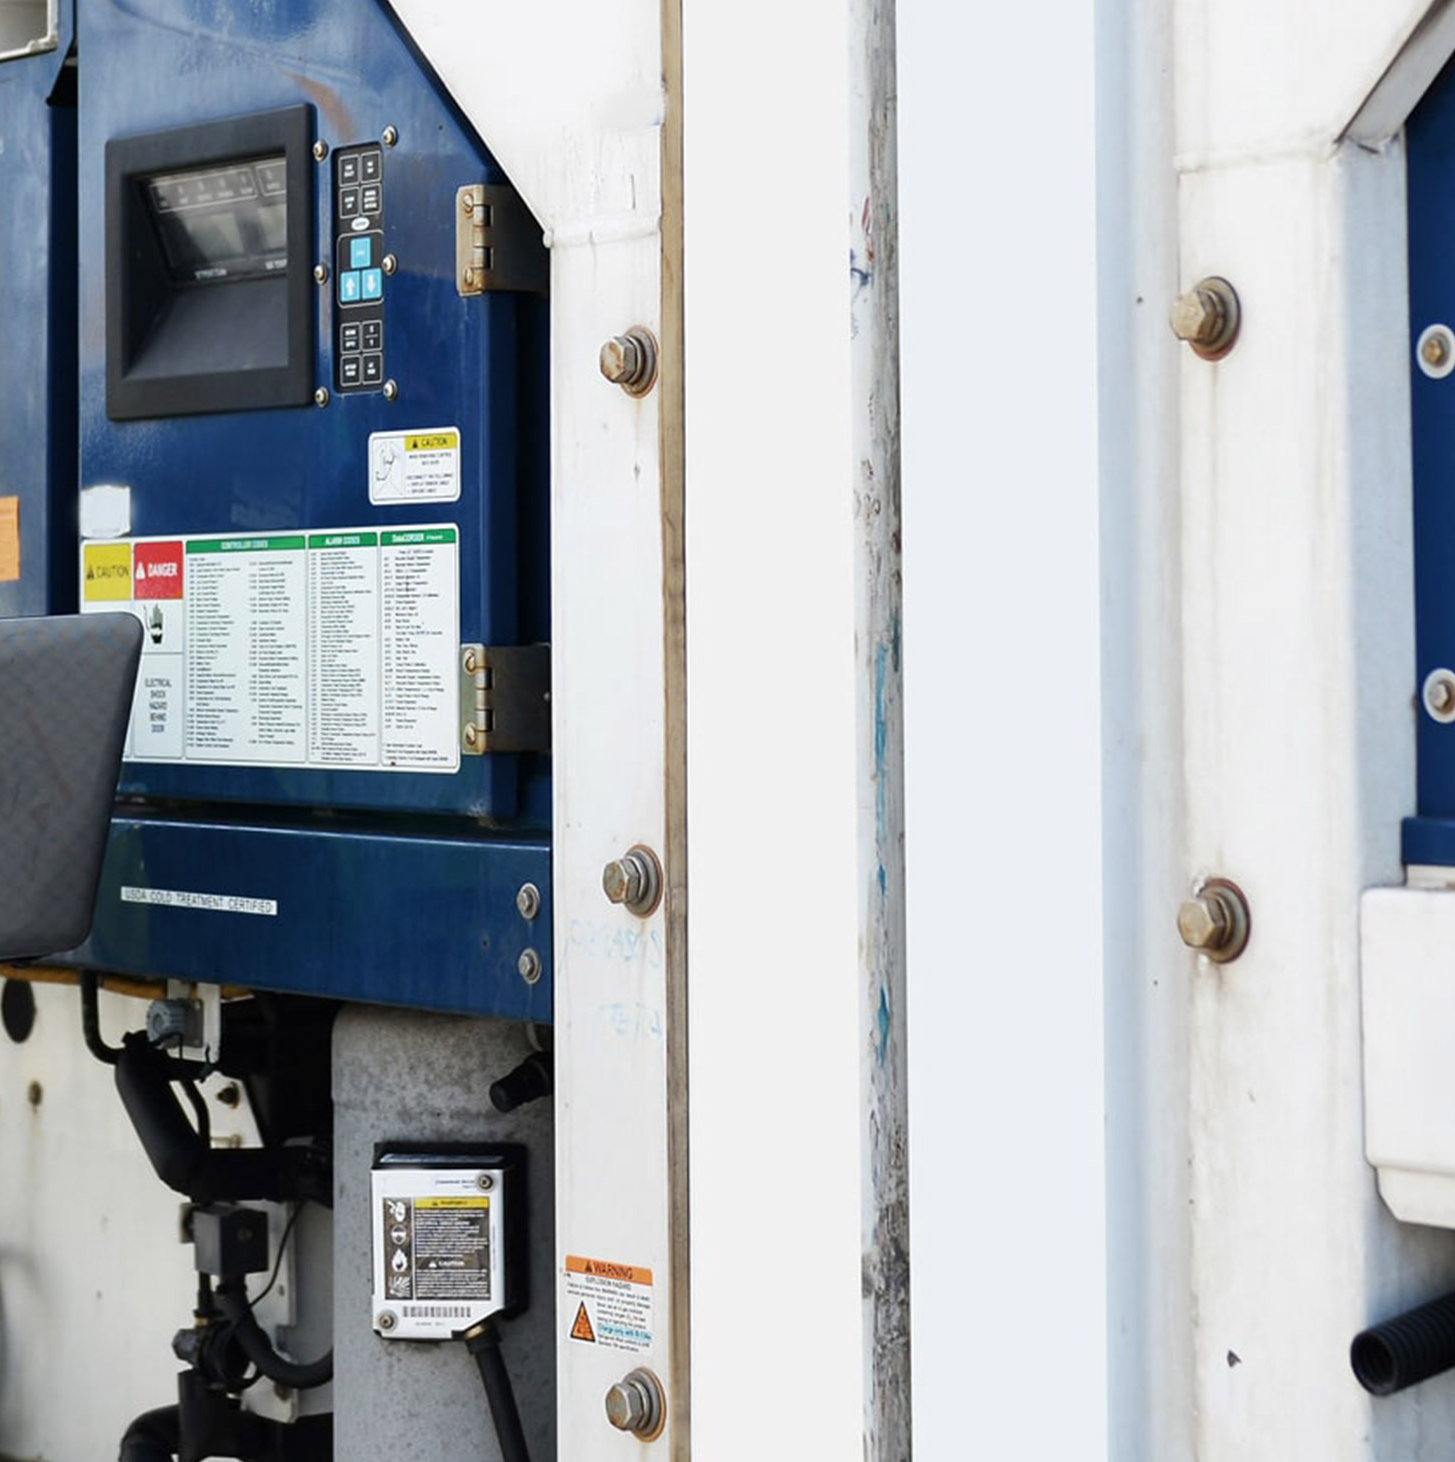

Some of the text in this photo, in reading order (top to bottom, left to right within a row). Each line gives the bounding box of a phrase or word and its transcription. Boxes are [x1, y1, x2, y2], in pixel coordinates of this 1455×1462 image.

[421, 436, 448, 447] CAUTION
[96, 565, 129, 579] CAUTION
[148, 562, 178, 578] DANGER
[124, 889, 273, 913] USDA COLD TREATMENT CERTIFIED
[593, 1261, 633, 1279] WARNING
